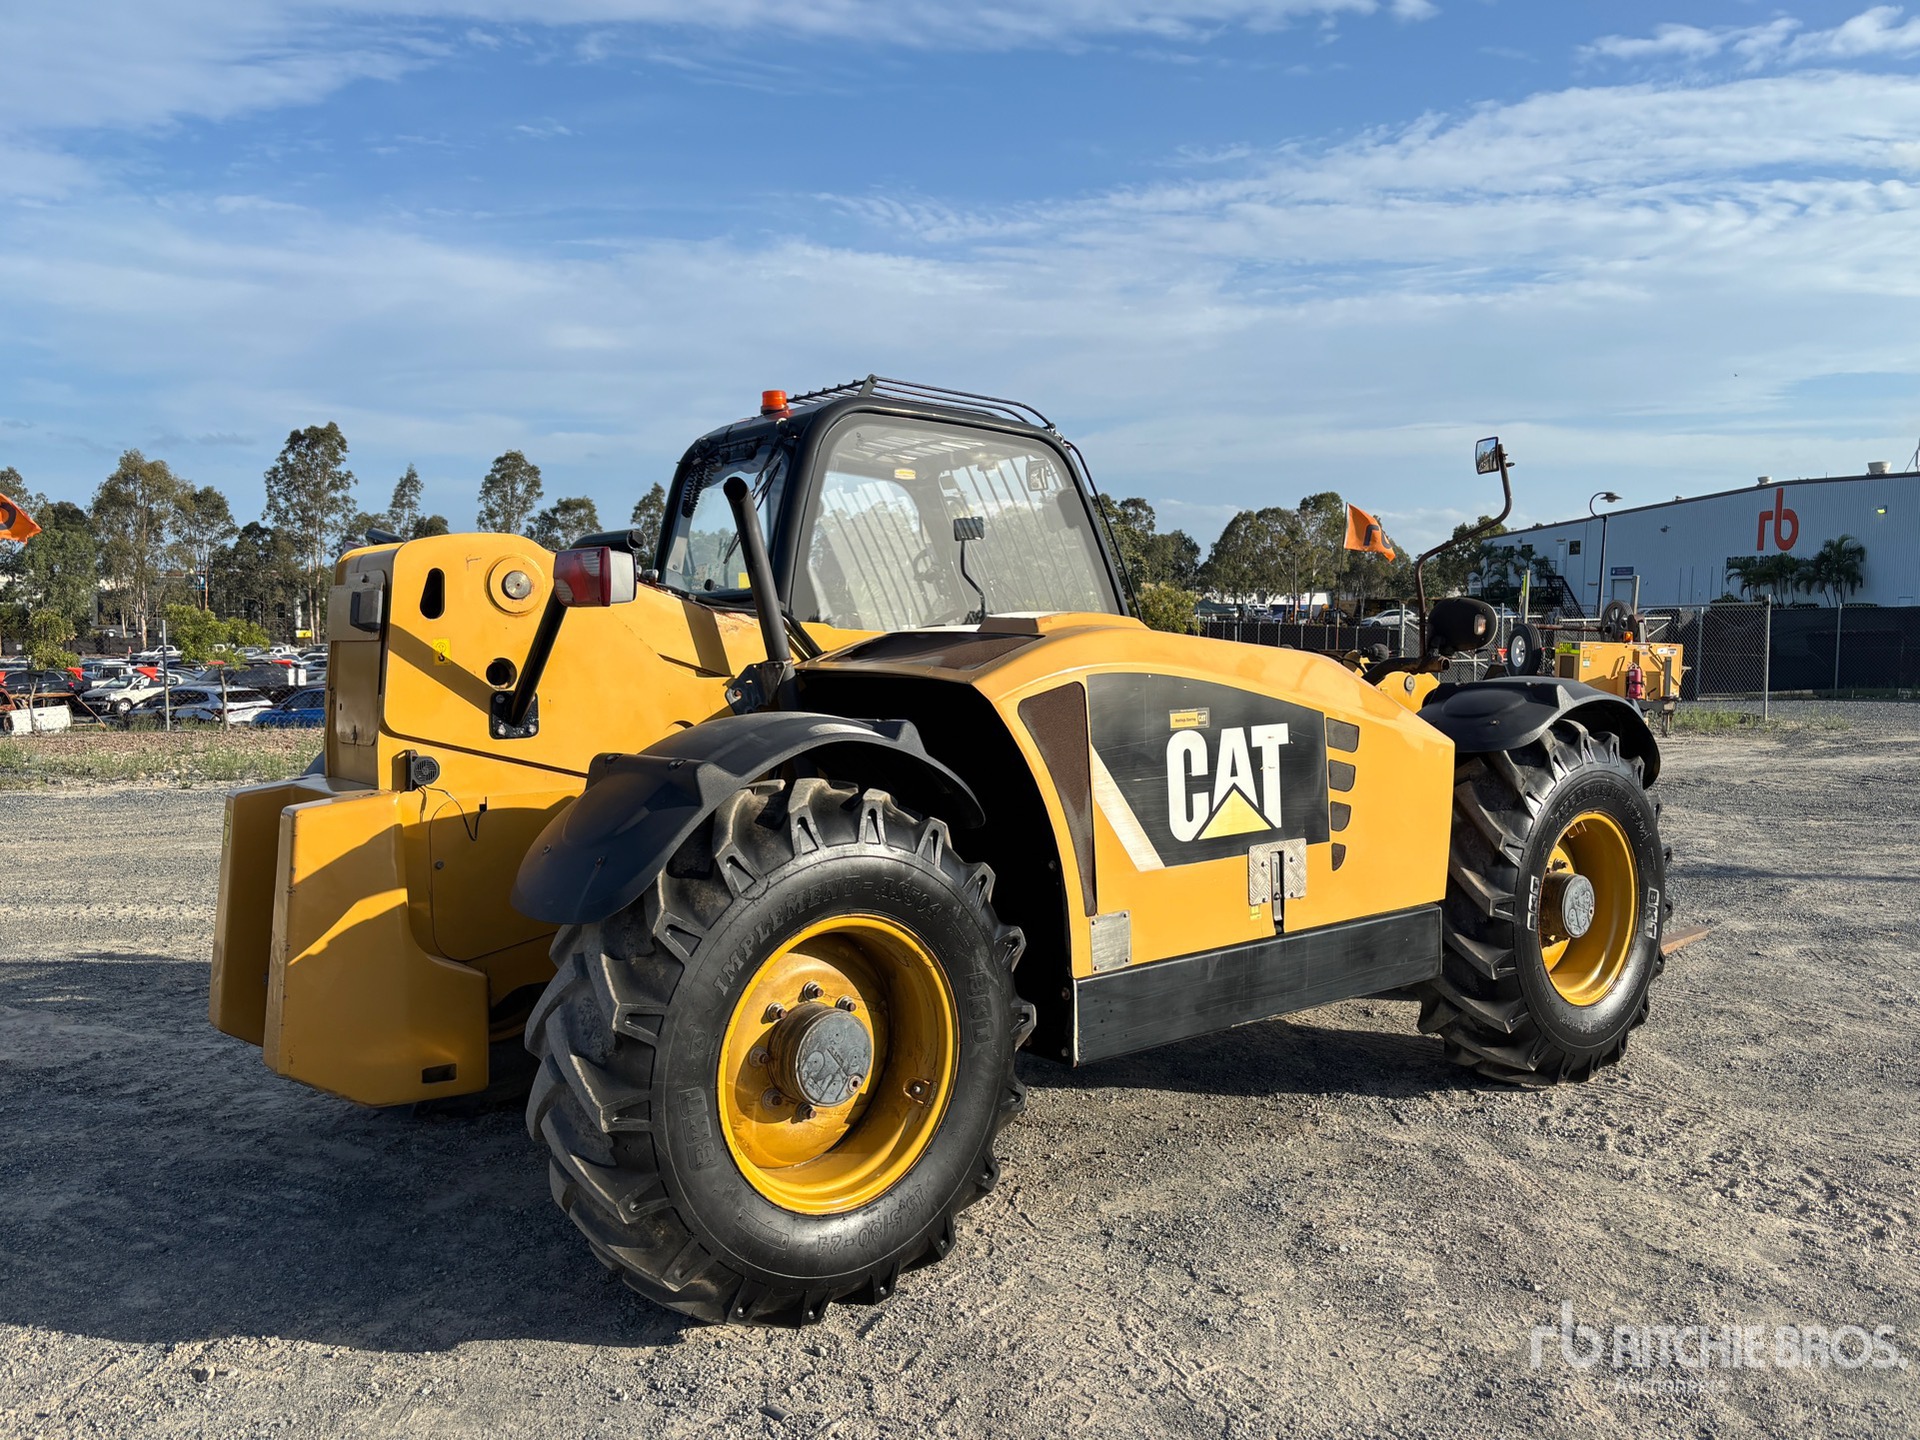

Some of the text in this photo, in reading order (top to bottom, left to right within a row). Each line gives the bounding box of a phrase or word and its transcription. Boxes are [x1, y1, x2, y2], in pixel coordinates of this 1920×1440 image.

[1757, 488, 1799, 551] rb
[1166, 723, 1289, 842] CAT
[712, 875, 862, 997] IMPLEMENT
